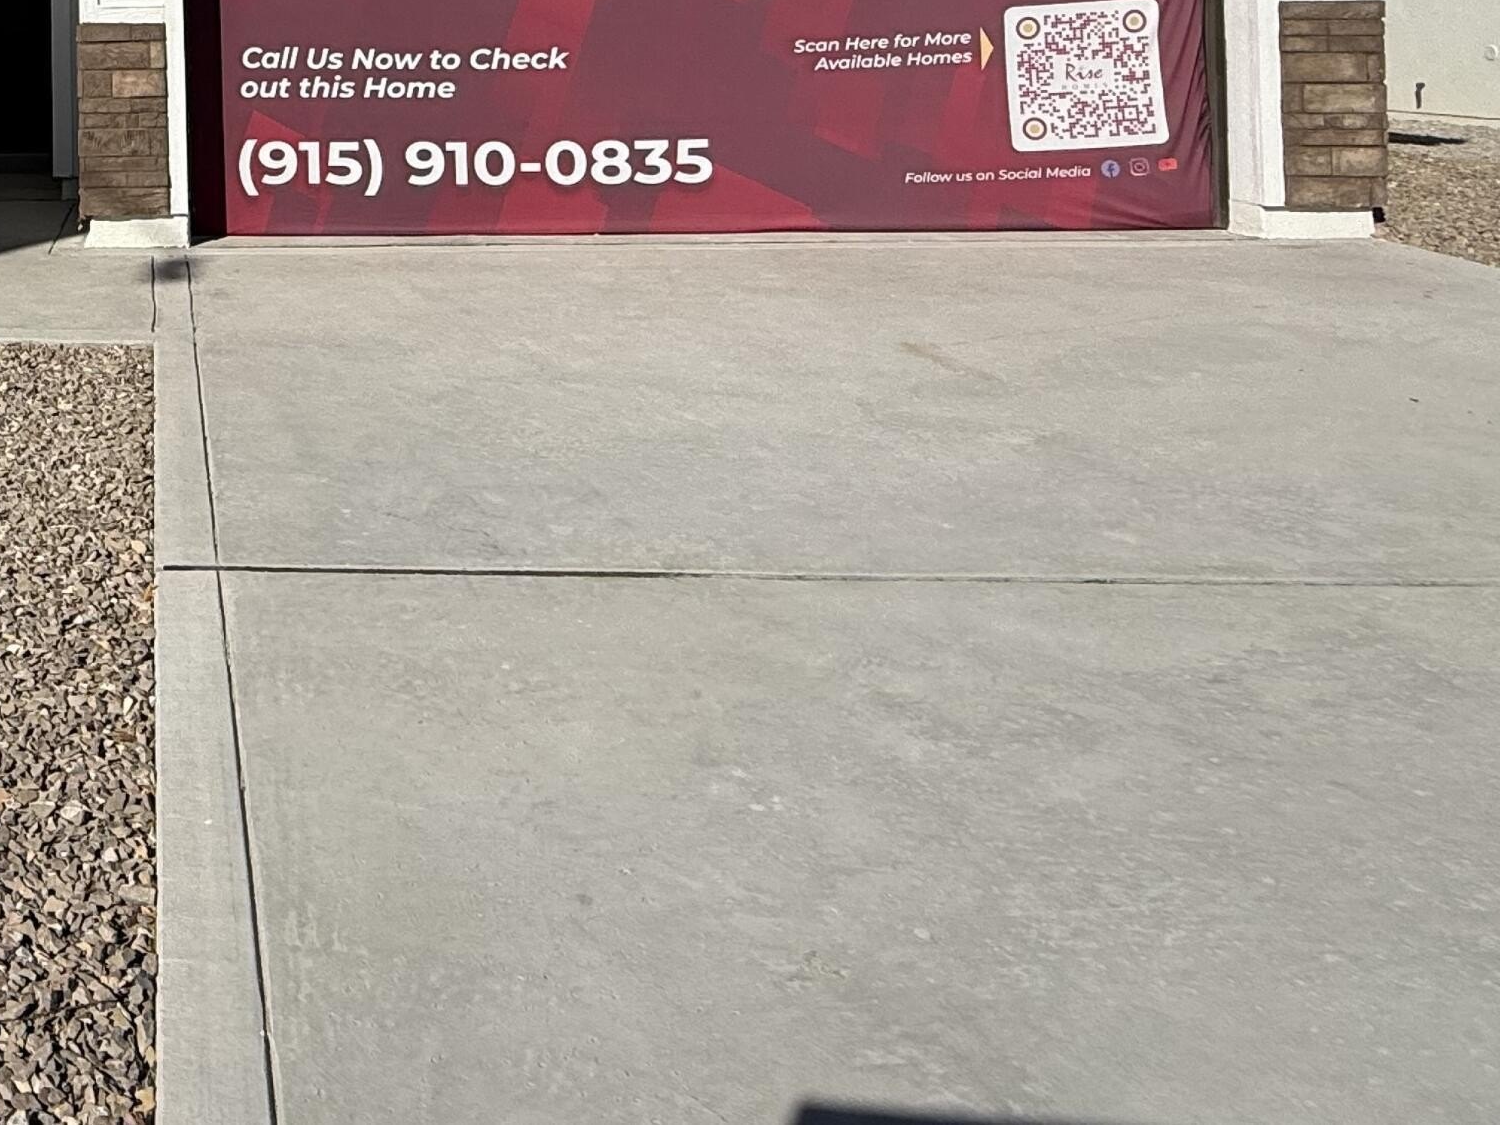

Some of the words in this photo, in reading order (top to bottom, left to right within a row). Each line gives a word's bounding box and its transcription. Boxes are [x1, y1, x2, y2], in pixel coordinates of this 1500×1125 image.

[793, 38, 840, 54] Scan
[845, 36, 889, 51] Here
[893, 33, 920, 49] for
[924, 32, 972, 47] More
[241, 46, 299, 70] Call
[306, 48, 344, 70] Us
[351, 48, 423, 70] Now
[430, 49, 461, 70] to
[469, 46, 569, 70] Check
[814, 53, 902, 72] Available
[907, 50, 973, 67] Homes
[1065, 63, 1102, 82] Rise
[240, 78, 291, 99] out
[299, 75, 356, 99] this
[363, 77, 456, 99] Home
[238, 138, 384, 197] (915)
[405, 138, 714, 186] 910-0835
[904, 171, 952, 185] Follow
[955, 171, 974, 183] us
[976, 170, 996, 182] on
[998, 166, 1043, 181] Social
[1045, 165, 1092, 179] Media
